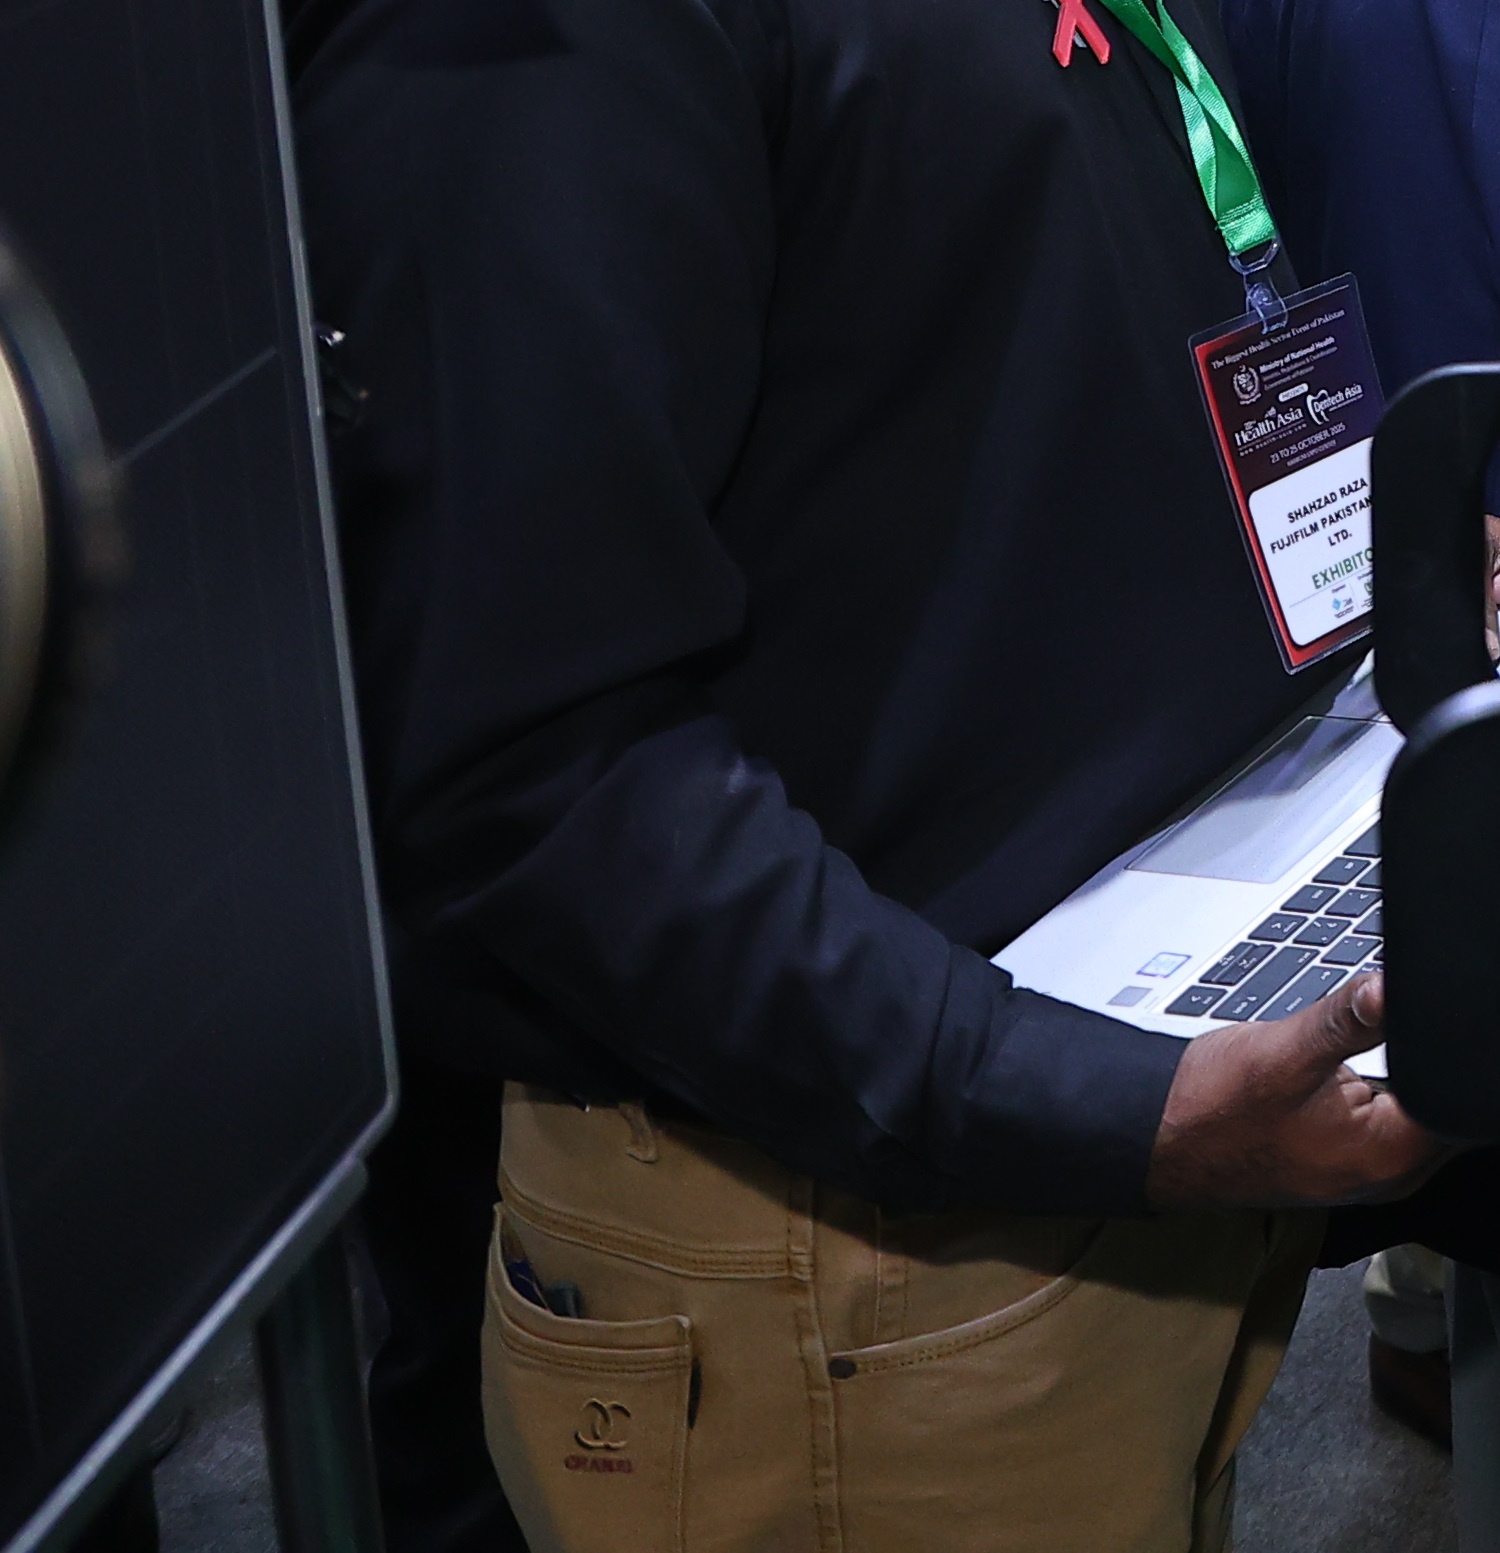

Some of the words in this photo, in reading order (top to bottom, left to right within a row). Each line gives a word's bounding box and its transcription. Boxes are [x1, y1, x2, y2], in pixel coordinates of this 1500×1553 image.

[1316, 309, 1345, 327] Pakistan
[1259, 356, 1284, 373] Ministry
[1290, 342, 1316, 360] National
[1315, 335, 1336, 350] Health
[1313, 390, 1346, 413] Dentech
[1344, 383, 1364, 400] Asia
[1235, 418, 1277, 446] Health
[1277, 407, 1304, 429] Asia
[1270, 452, 1281, 464] 23
[1279, 448, 1291, 459] TO
[1297, 429, 1331, 451] OCTOBER
[1330, 421, 1347, 437] 2025
[1287, 491, 1338, 524] SHAHZAD
[1339, 477, 1369, 499] RAZA
[1270, 521, 1320, 554] FUJIFILM
[1327, 528, 1353, 547] LTD.
